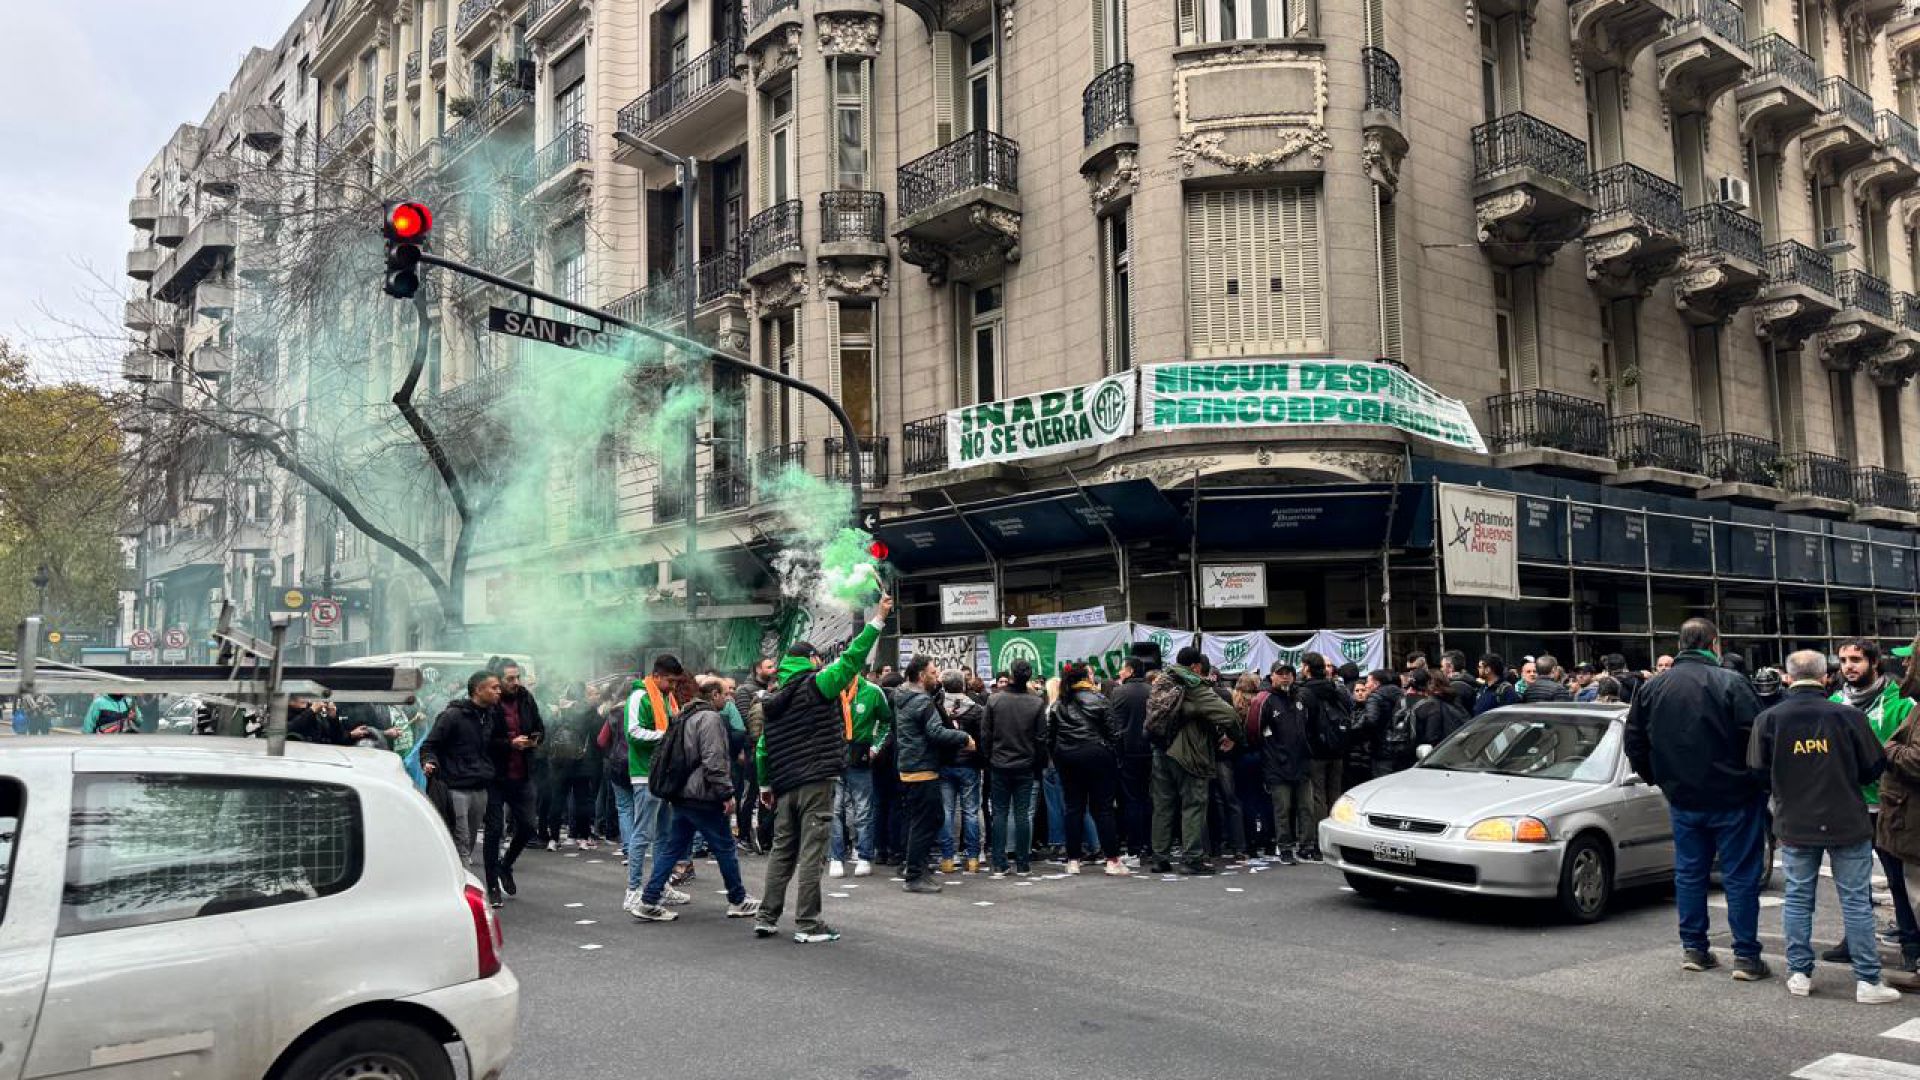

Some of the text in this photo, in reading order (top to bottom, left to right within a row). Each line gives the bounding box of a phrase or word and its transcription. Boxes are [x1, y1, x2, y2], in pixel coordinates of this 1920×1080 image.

[503, 312, 556, 341] SAN
[1154, 362, 1290, 393] NINGUN
[961, 386, 1084, 433] INADI
[960, 411, 1093, 461] NO SE CIERRA
[1464, 506, 1513, 528] Andamios
[1474, 522, 1513, 542] Buenos
[1471, 537, 1498, 554] Aires
[918, 638, 957, 655] BASTA
[1793, 739, 1828, 754] APN
